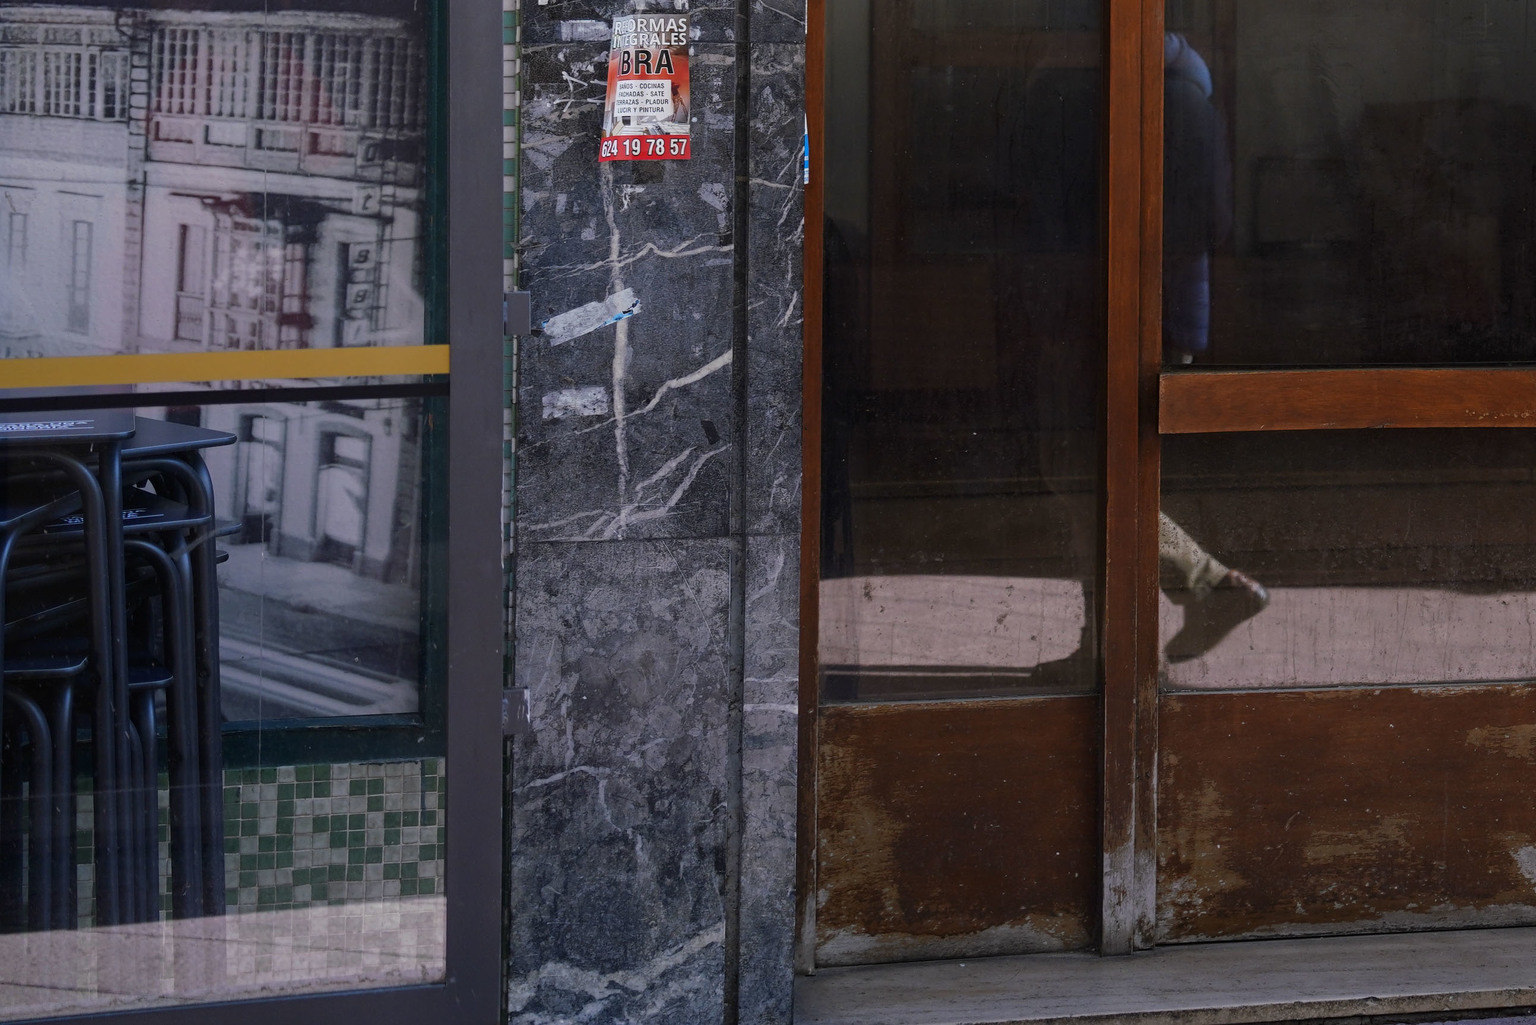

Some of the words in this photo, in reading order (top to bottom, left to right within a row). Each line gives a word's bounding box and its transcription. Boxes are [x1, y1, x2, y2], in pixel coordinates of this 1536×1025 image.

[601, 139, 618, 158] 624
[623, 139, 641, 156] 19
[646, 138, 665, 155] 78
[670, 138, 687, 155] 57
